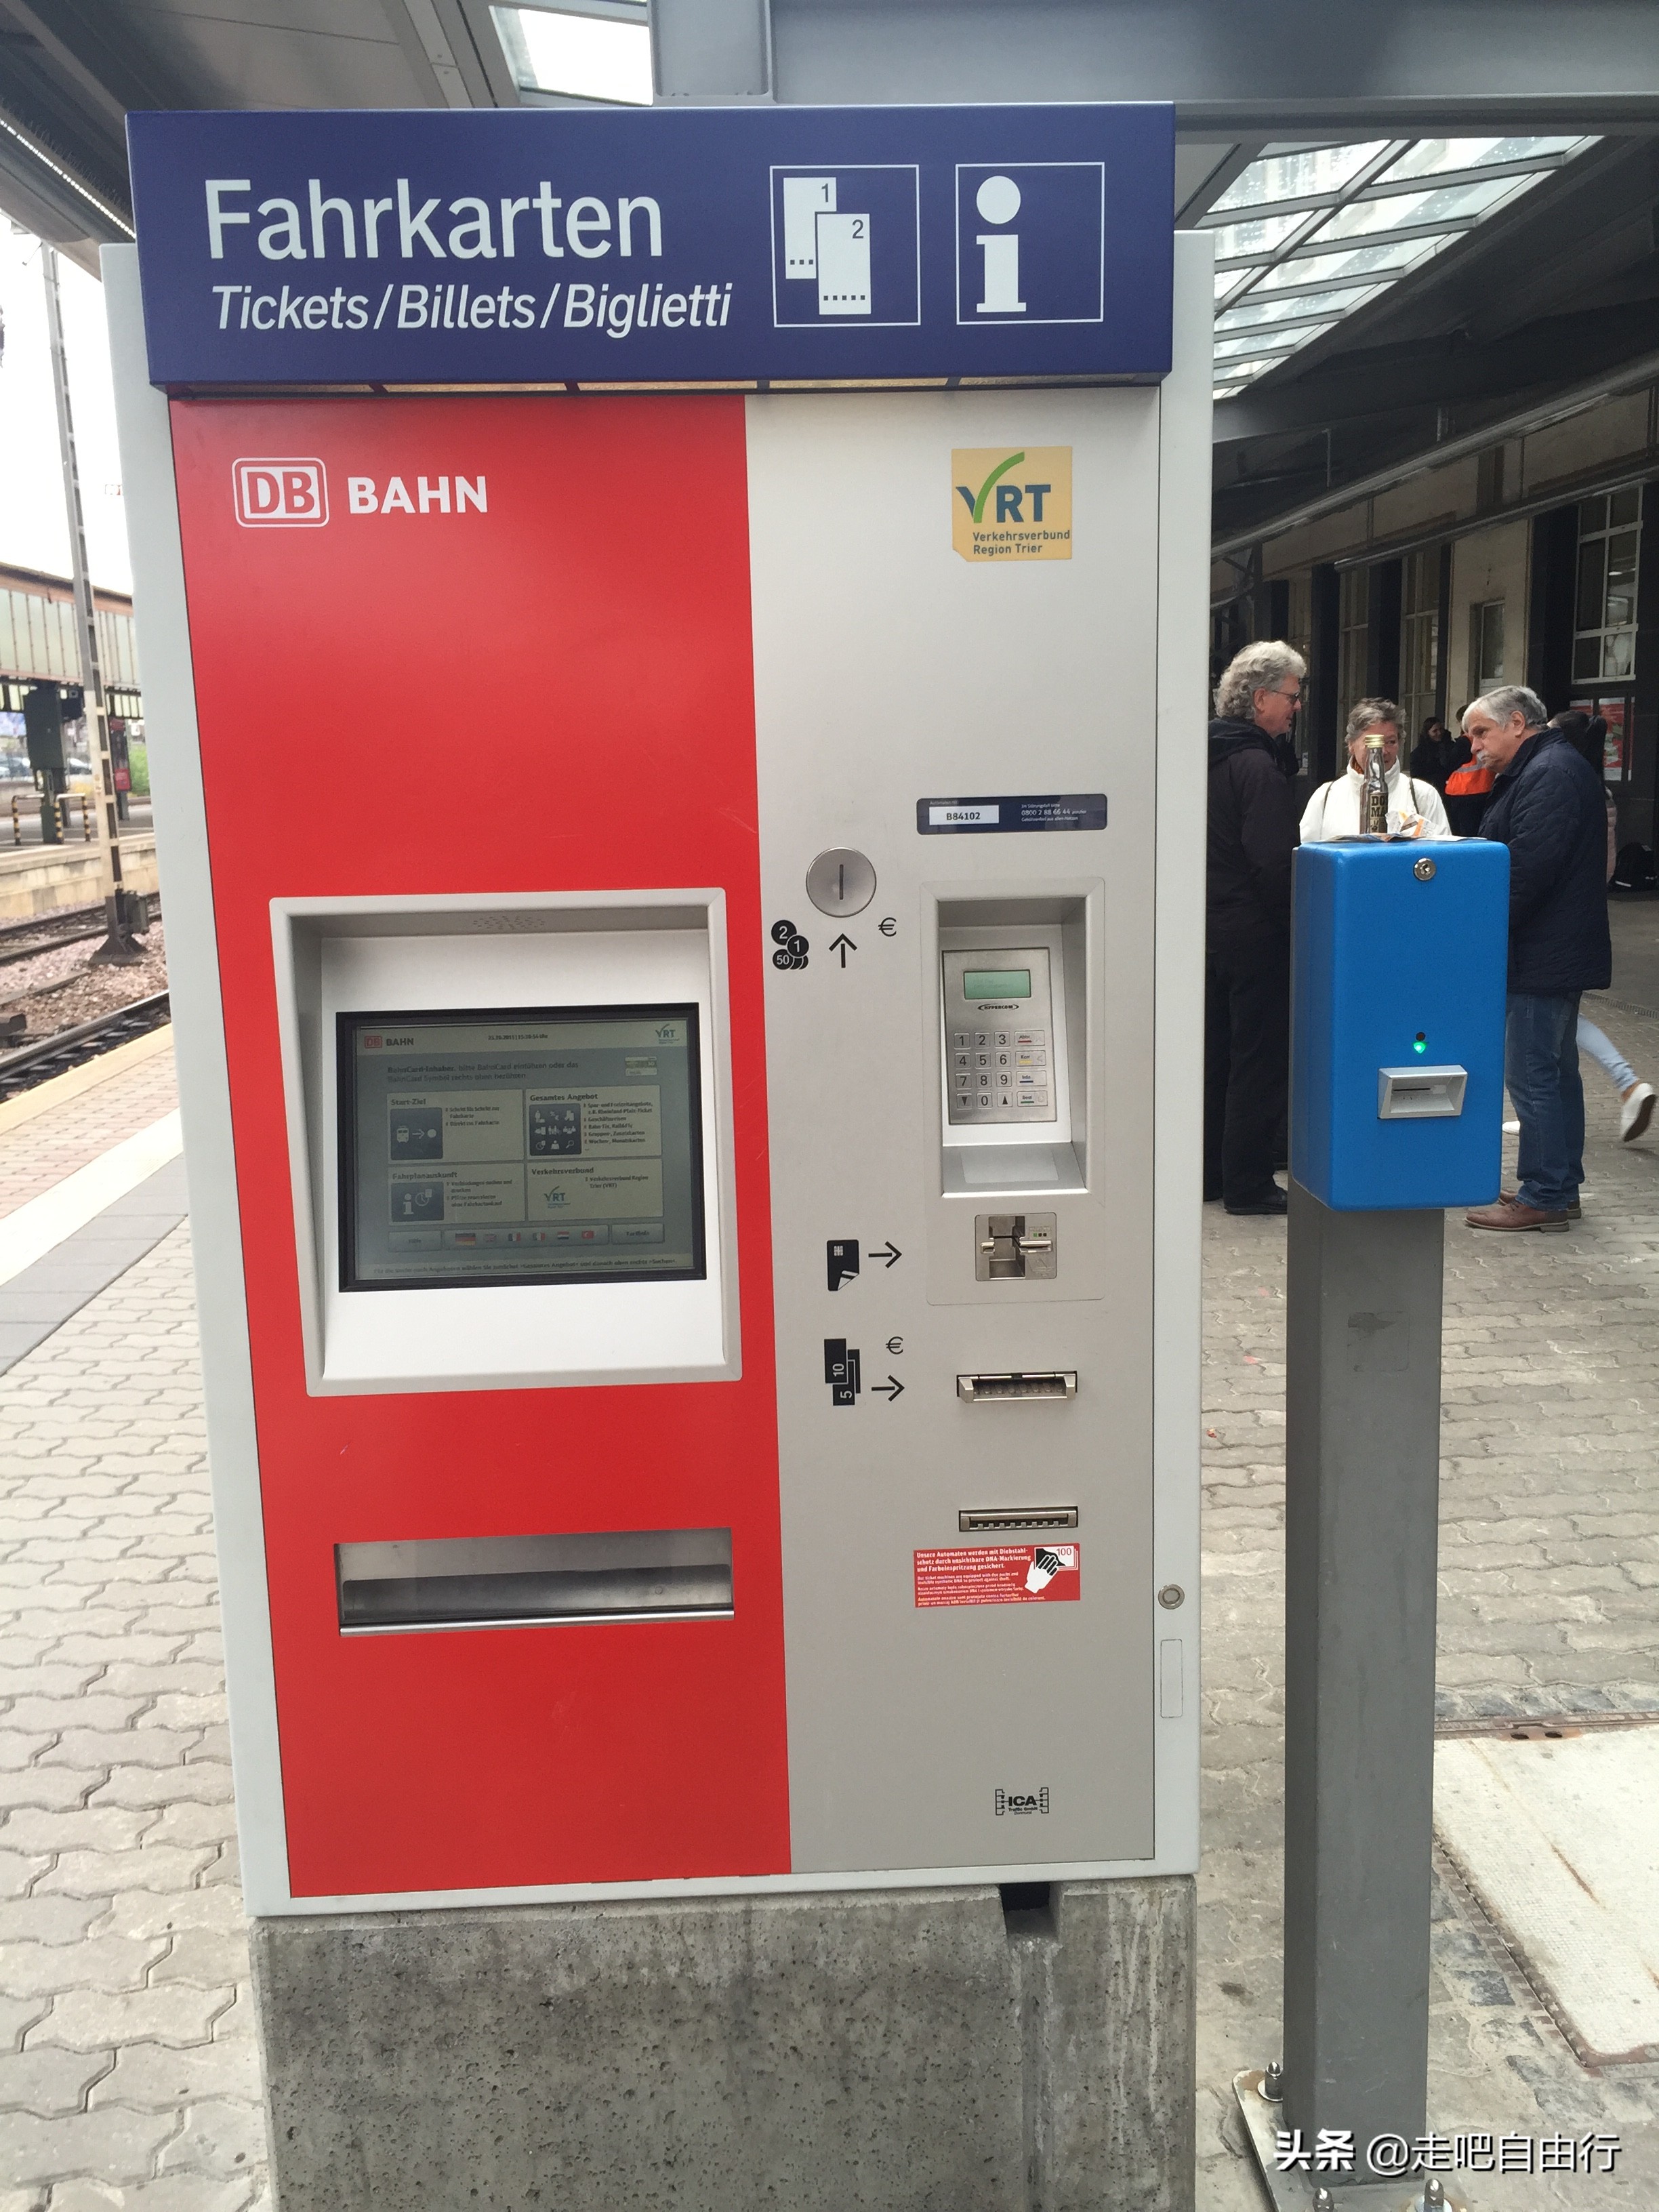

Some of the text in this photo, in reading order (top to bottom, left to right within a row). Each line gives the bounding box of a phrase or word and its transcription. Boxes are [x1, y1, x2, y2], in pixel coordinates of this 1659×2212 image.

[820, 184, 831, 203] 1
[205, 178, 662, 260] Fahrkarten
[852, 220, 864, 239] 2
[243, 467, 488, 518] DB BAHN
[956, 451, 1051, 524] VRT
[972, 530, 1070, 541] Verkehrsverbund
[973, 544, 1043, 556] Region Trier
[946, 812, 981, 821] B84102
[779, 924, 788, 940] 2
[878, 917, 897, 938] €
[794, 940, 801, 954] 1
[776, 954, 790, 966] 50
[366, 1036, 415, 1048] DB BAHN
[959, 1036, 964, 1046] 1
[979, 1035, 986, 1046] 2
[999, 1034, 1006, 1045] 3
[960, 1056, 967, 1066] 4
[979, 1055, 987, 1065] 5
[1000, 1054, 1007, 1065] 6
[424, 1074, 450, 1082] Symbol
[960, 1076, 967, 1086] 7
[980, 1076, 988, 1086] 8
[1000, 1074, 1008, 1085] 9
[567, 1093, 598, 1101] Angebot
[981, 1095, 989, 1106] 0
[392, 1172, 457, 1181] Fahrplanauskunft
[544, 1185, 566, 1202] VRT
[832, 1362, 845, 1377] 10
[840, 1390, 853, 1399] 5
[1000, 1547, 1028, 1555] Diebstahl-
[1056, 1547, 1072, 1556] 100
[928, 1564, 977, 1572] Farbeinspritzung
[977, 1563, 1005, 1571] gesichert.
[1008, 1795, 1038, 1807] ICA
